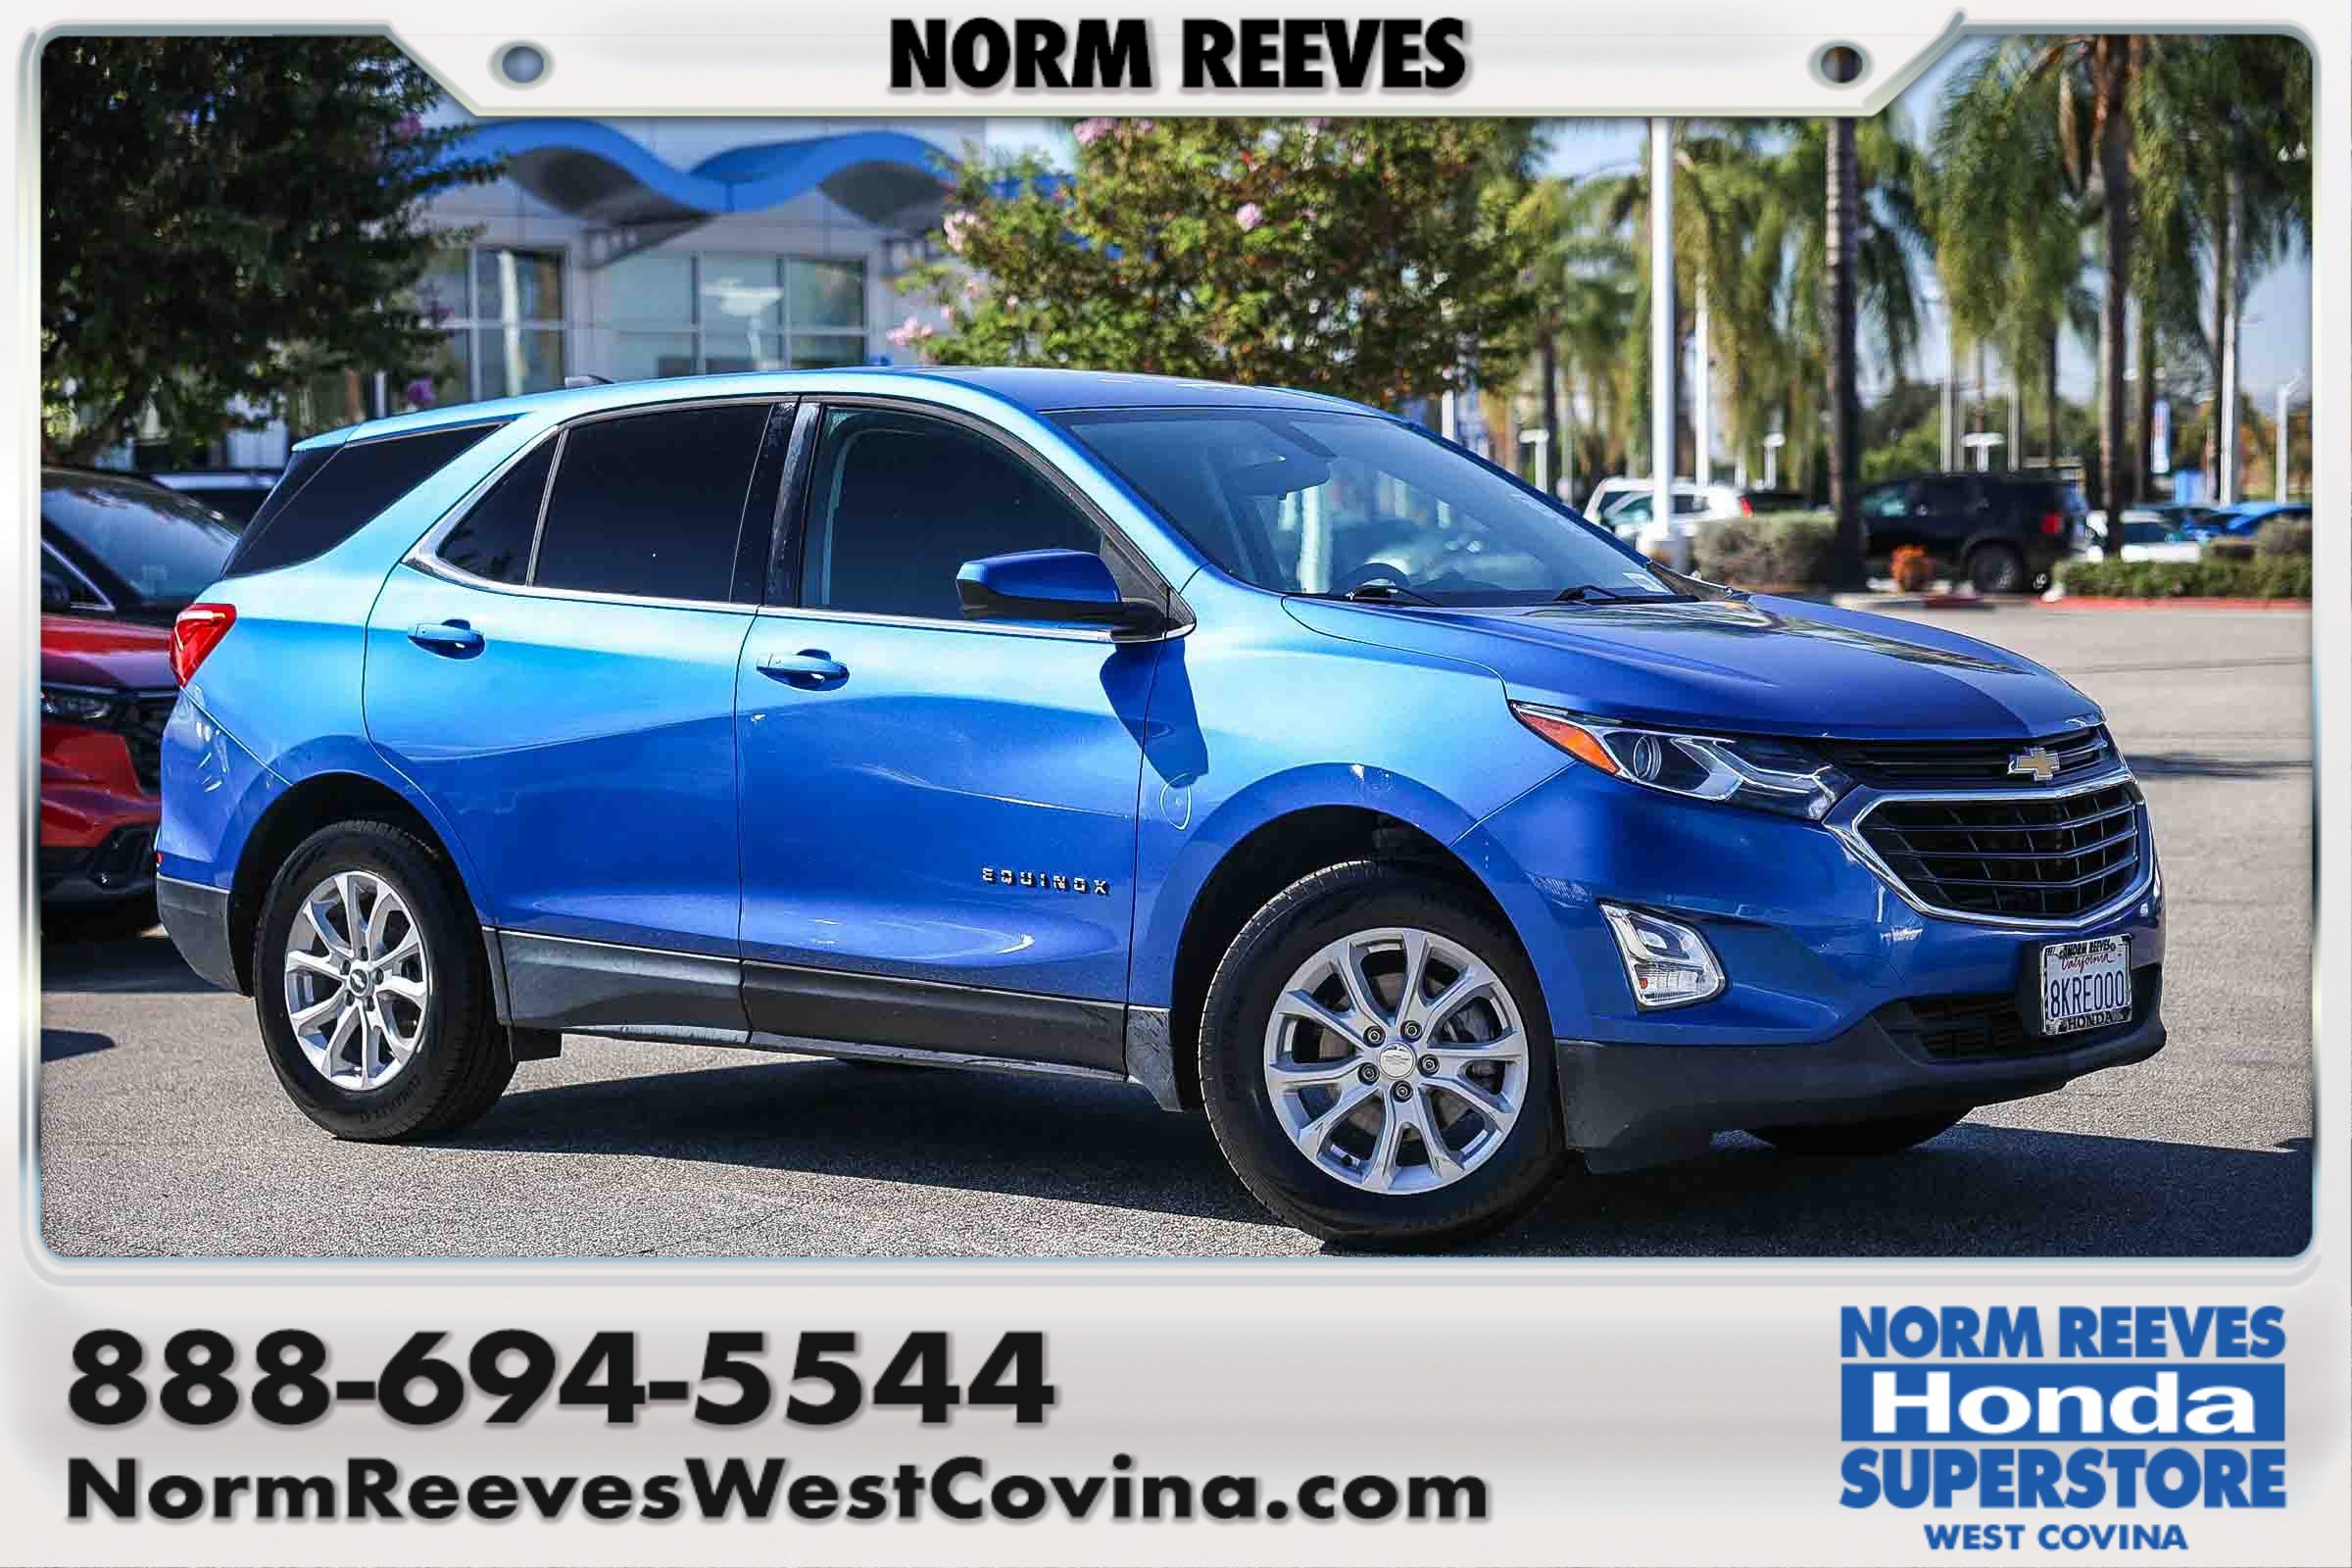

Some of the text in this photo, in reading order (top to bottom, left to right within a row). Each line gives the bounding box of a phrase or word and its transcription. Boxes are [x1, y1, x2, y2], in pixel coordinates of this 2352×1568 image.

[982, 867, 1108, 895] EQUINOX
[2050, 969, 2126, 1018] 8KRE000
[2067, 1010, 2114, 1030] HONDA
